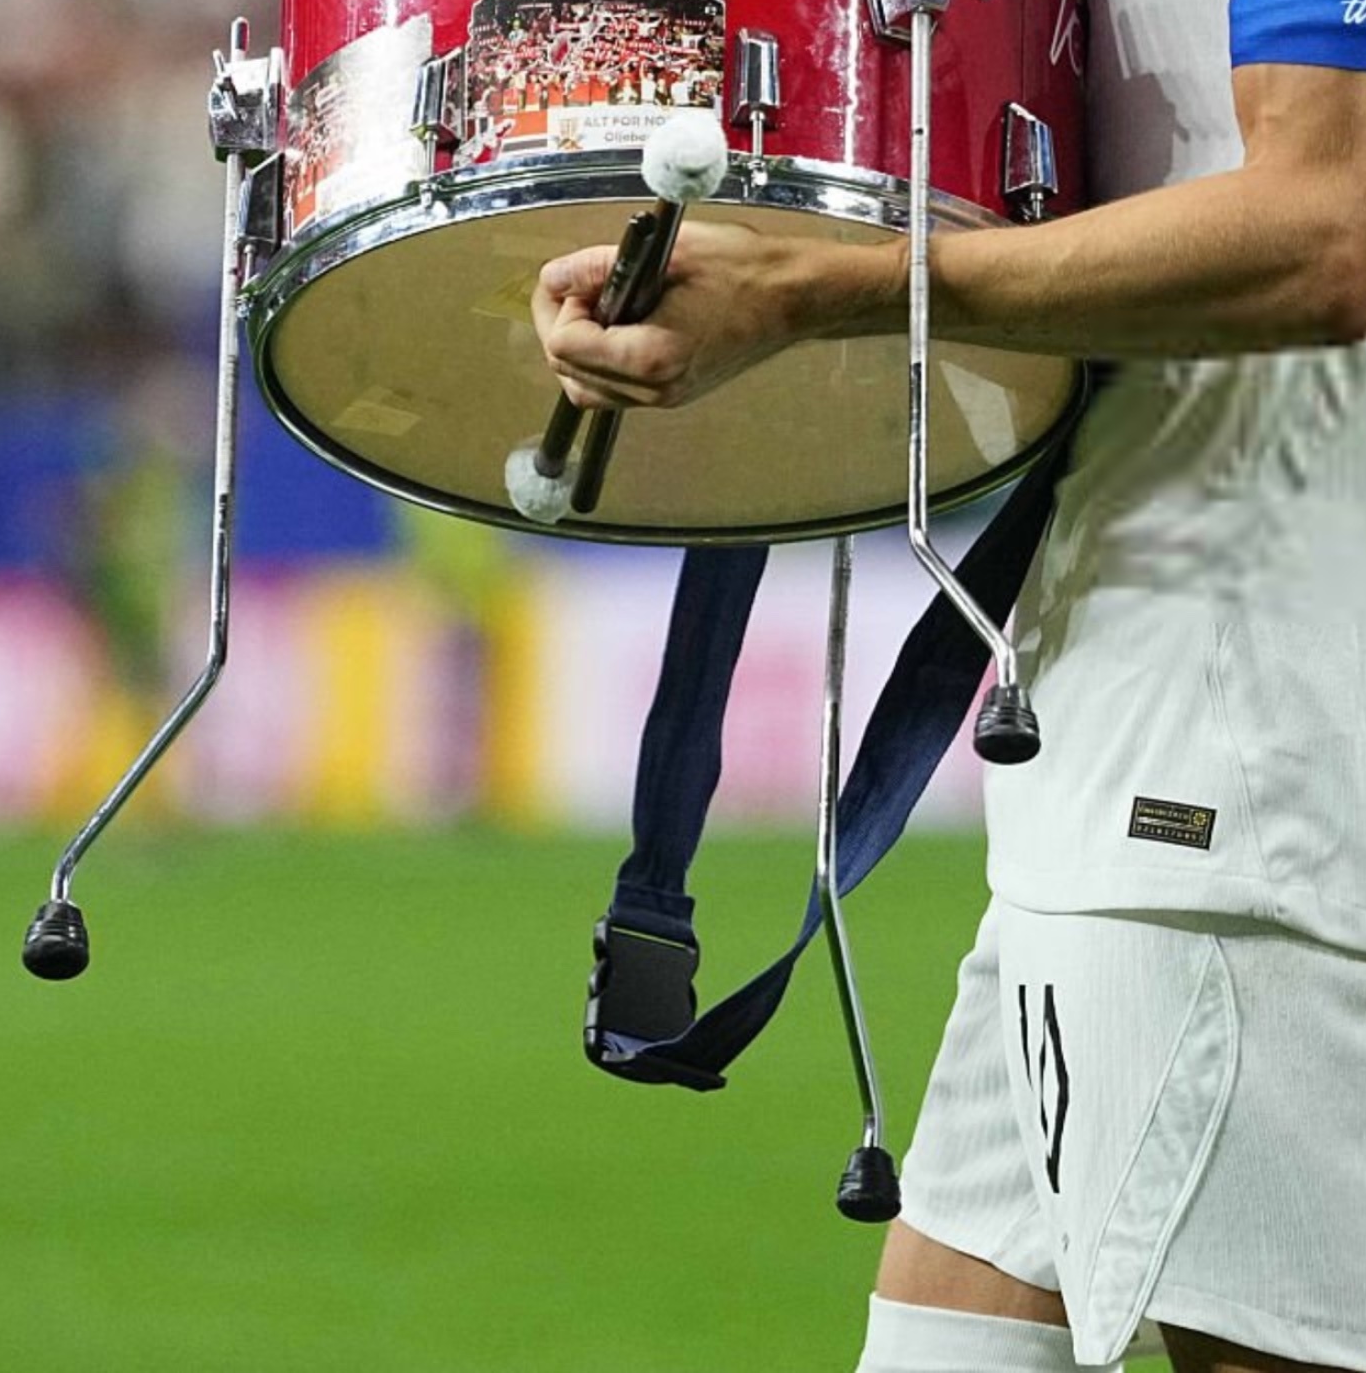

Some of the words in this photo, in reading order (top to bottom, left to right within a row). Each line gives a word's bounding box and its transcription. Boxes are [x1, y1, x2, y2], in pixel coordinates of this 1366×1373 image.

[584, 115, 608, 127] ALT
[612, 115, 640, 127] FOR
[644, 114, 668, 127] NO
